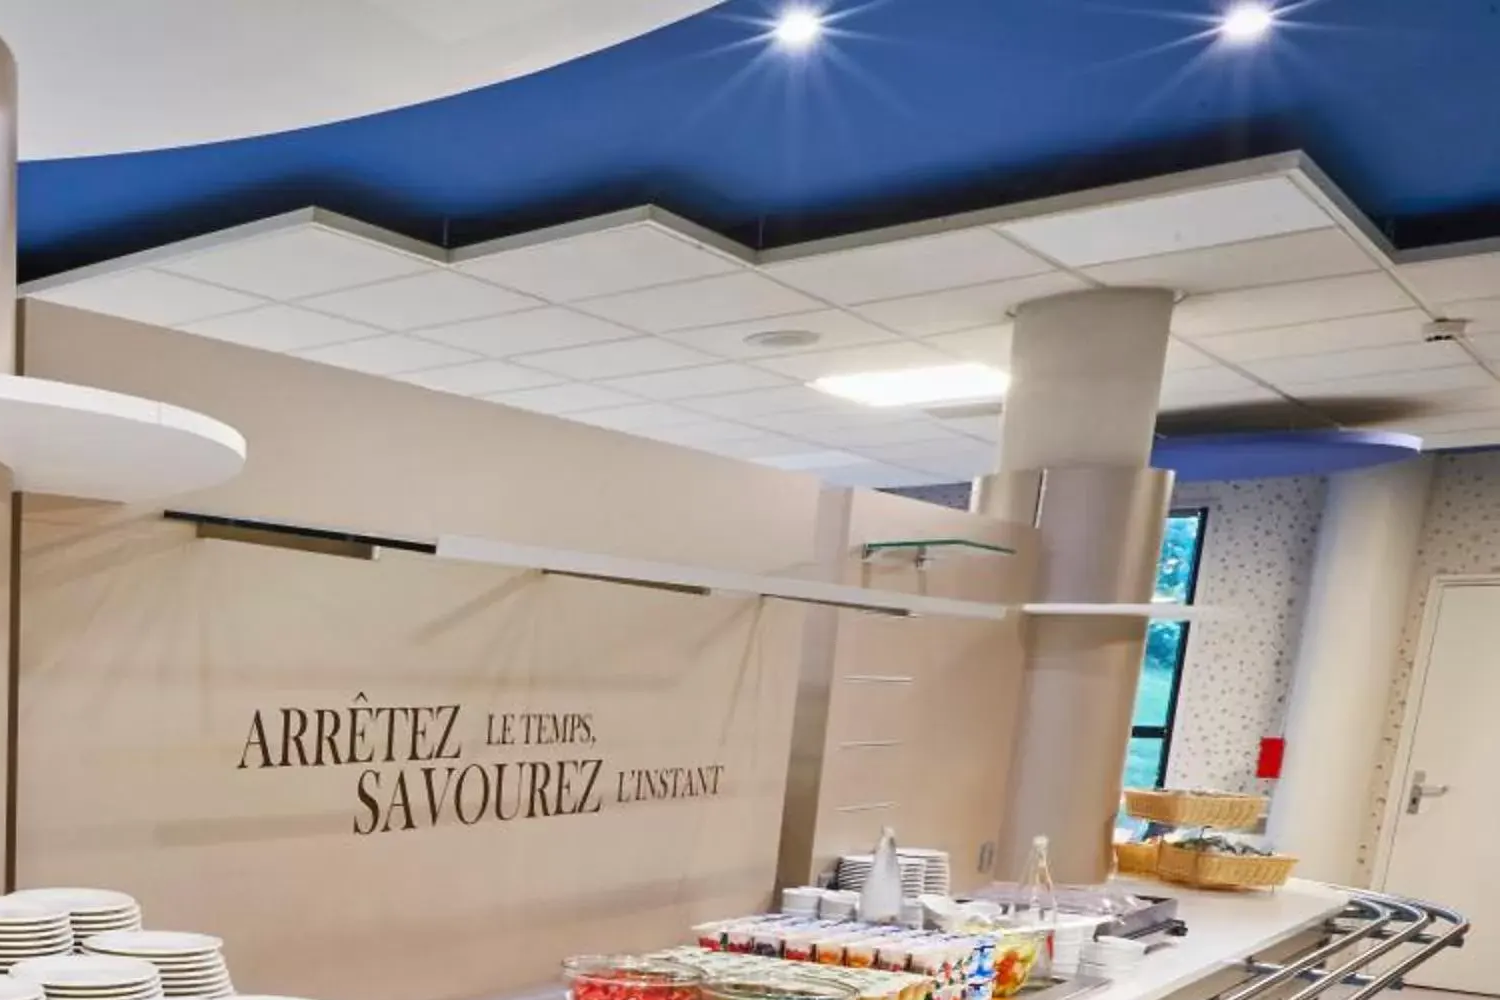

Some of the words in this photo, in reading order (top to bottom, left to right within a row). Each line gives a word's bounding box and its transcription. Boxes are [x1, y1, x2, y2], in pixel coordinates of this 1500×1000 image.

[236, 691, 462, 769] ARRÊTEZ
[485, 713, 515, 745] LE
[519, 712, 597, 750] TEMPS,
[353, 759, 603, 835] SAVOUREZ
[616, 765, 725, 803] L'INSTANT
